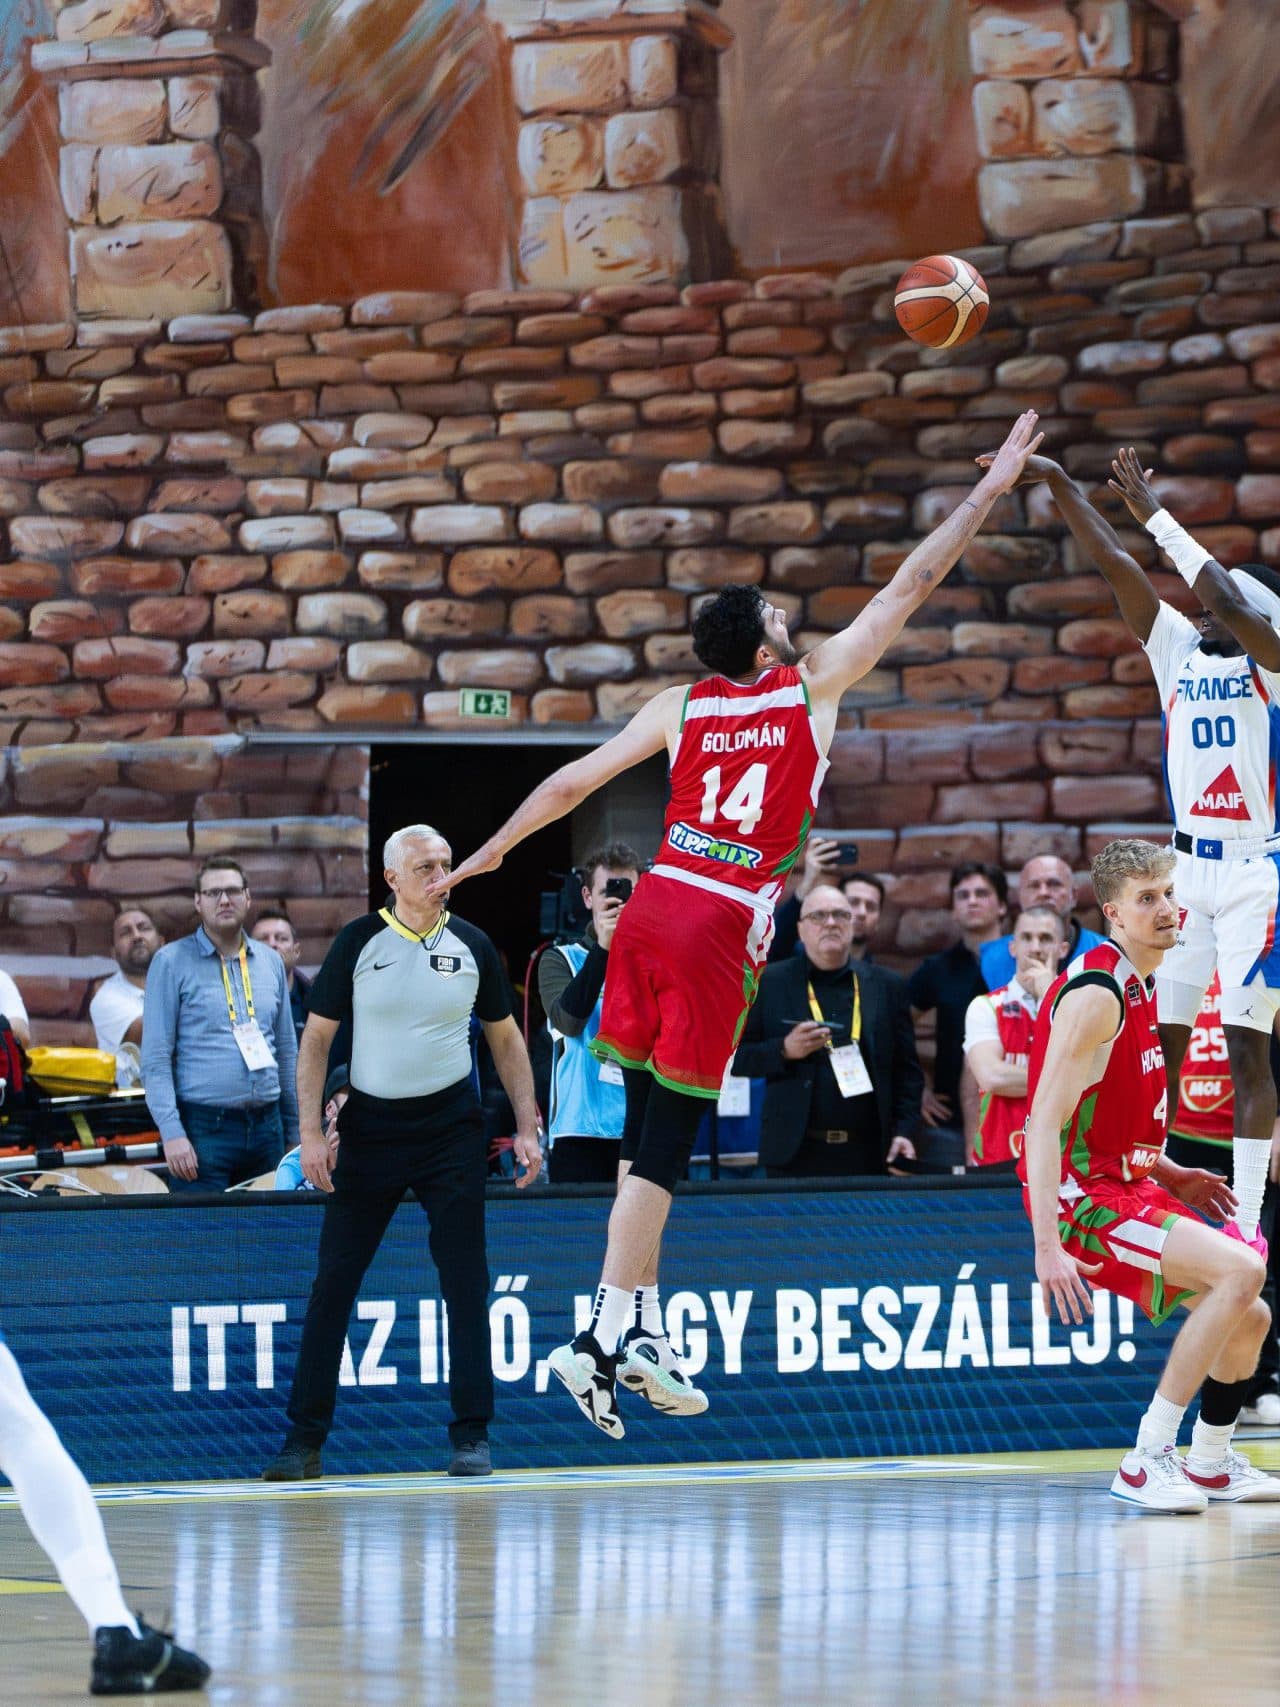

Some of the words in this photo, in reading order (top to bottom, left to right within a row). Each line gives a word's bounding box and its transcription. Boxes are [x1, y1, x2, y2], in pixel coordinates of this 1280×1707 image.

[1176, 674, 1253, 702] FRANCE
[702, 722, 786, 753] GOLDMÁN
[1192, 715, 1236, 749] 00
[700, 763, 768, 835] 14
[1199, 792, 1245, 810] MAIF
[1189, 1027, 1230, 1062] 25
[1189, 1081, 1222, 1096] MOL
[171, 1303, 287, 1392] ITT
[419, 1275, 550, 1393] IŐ,
[776, 1262, 1137, 1374] BESZÁLLJ!
